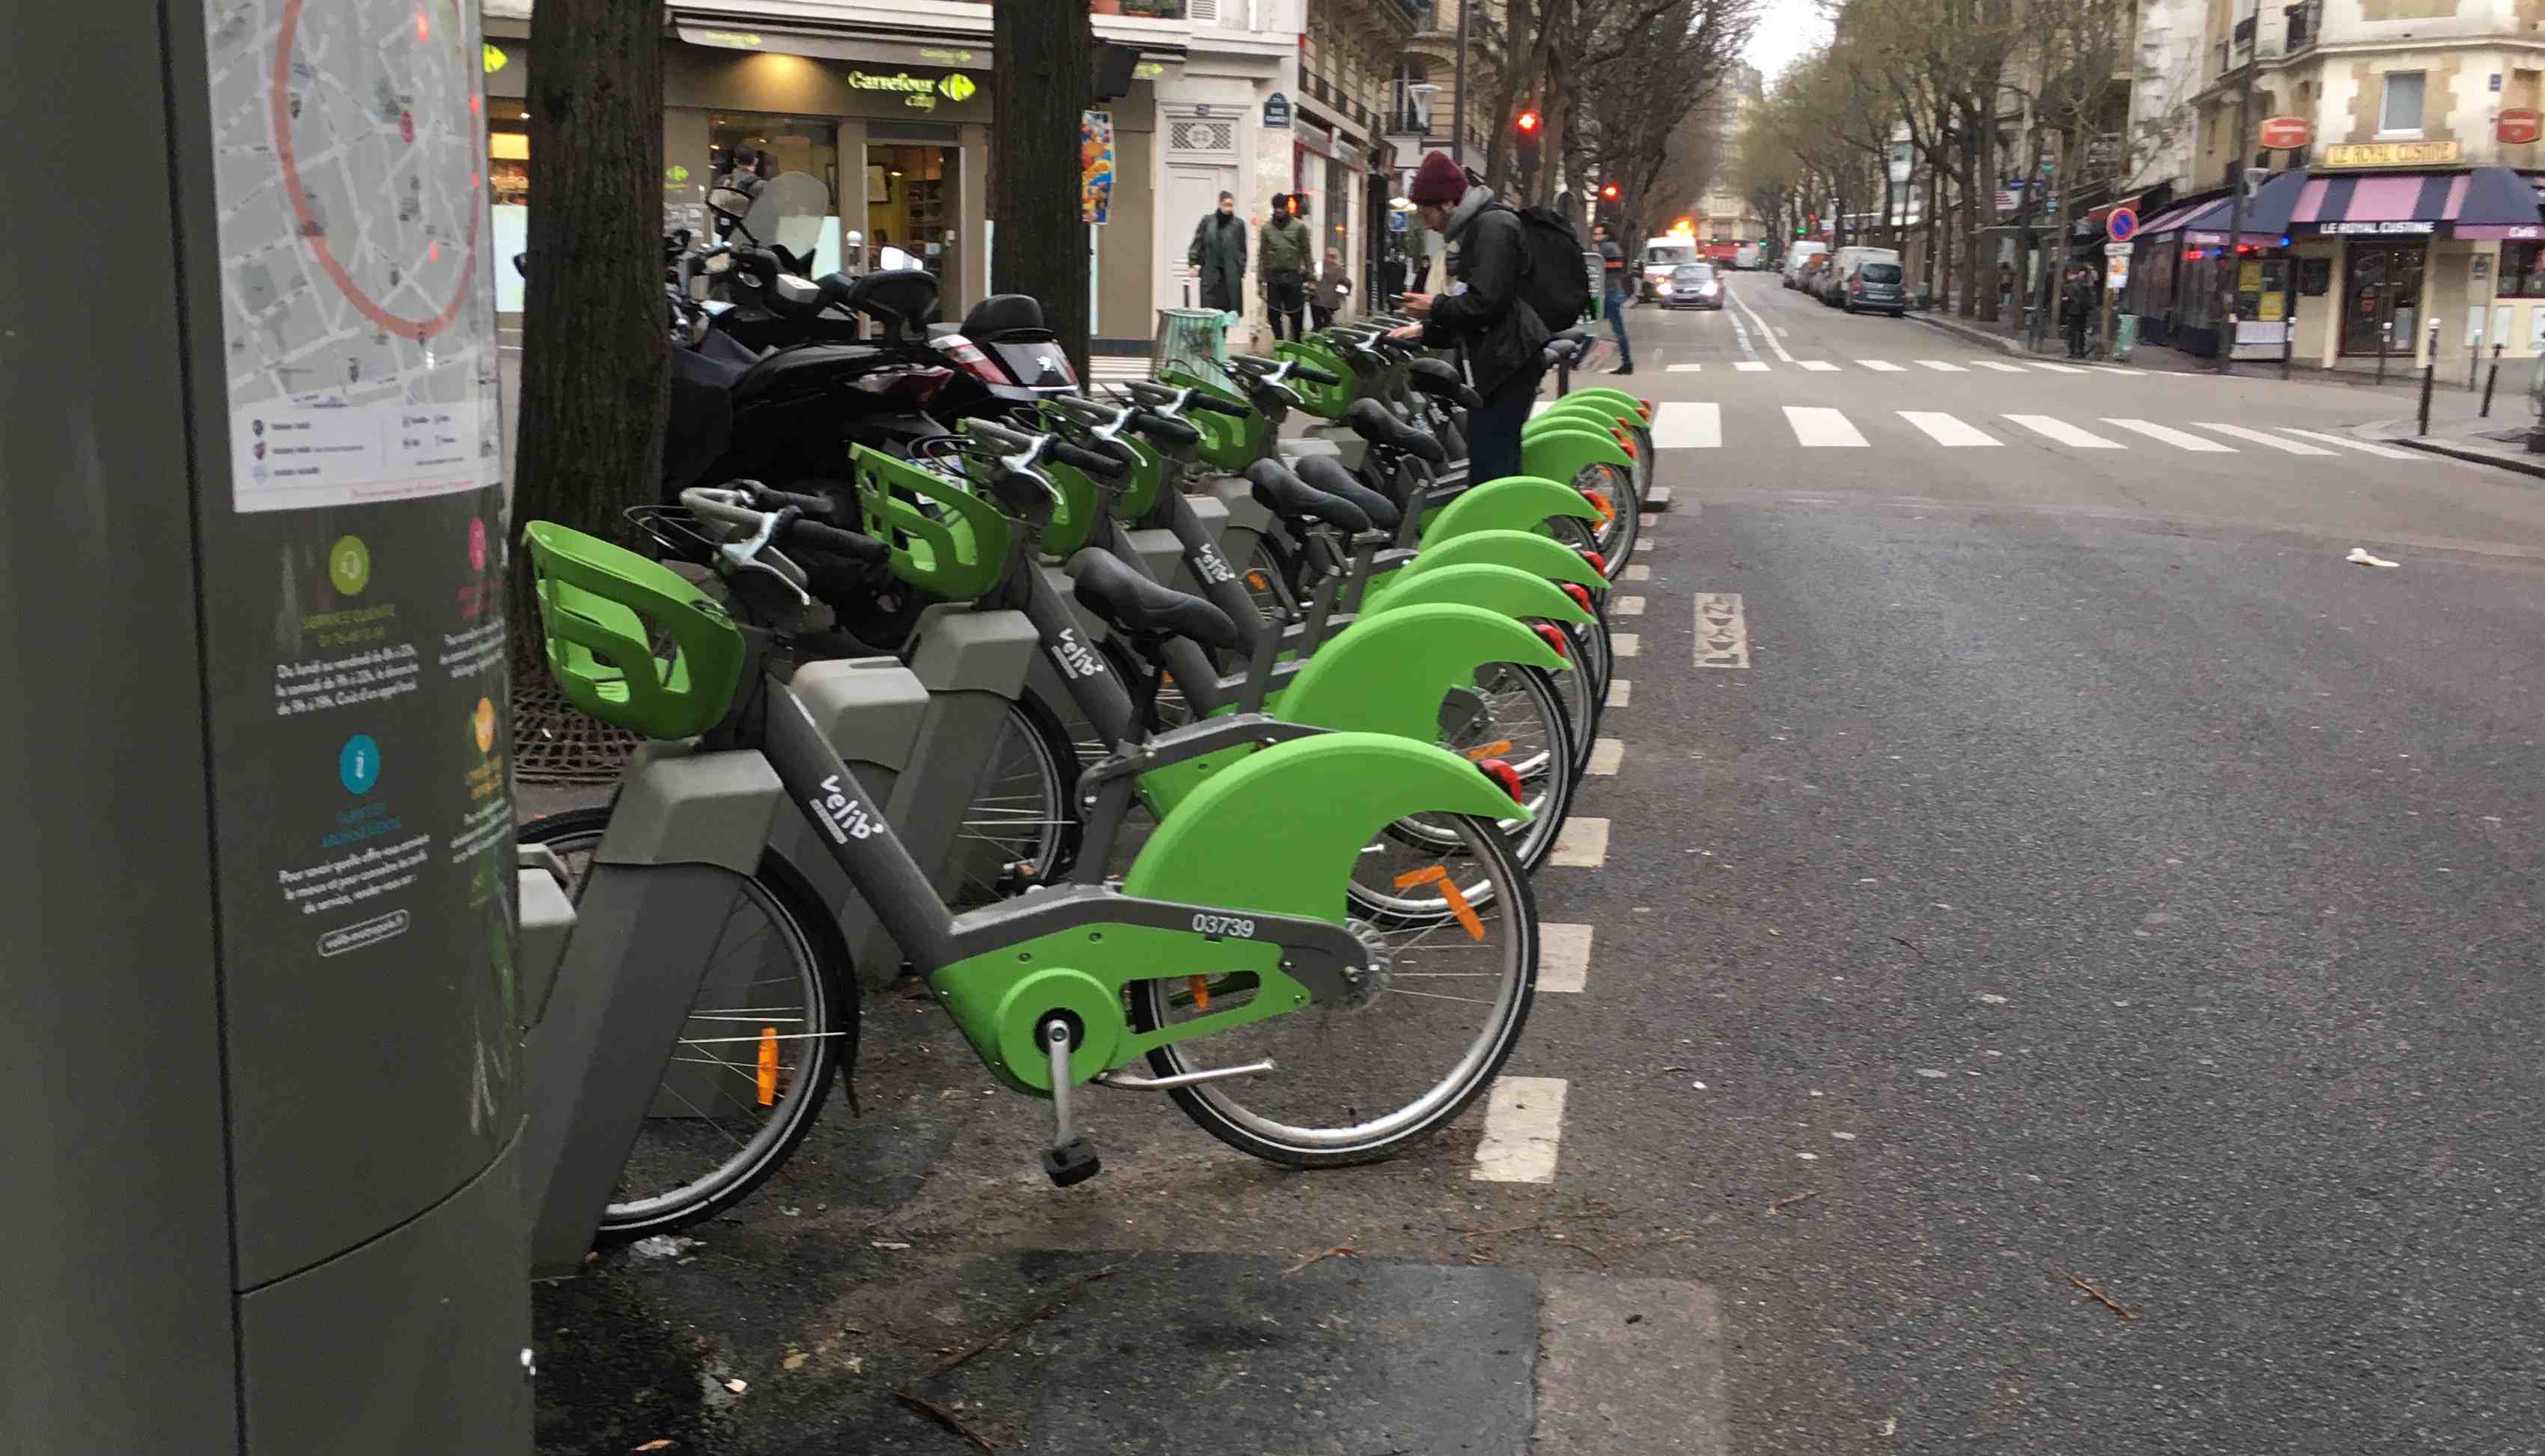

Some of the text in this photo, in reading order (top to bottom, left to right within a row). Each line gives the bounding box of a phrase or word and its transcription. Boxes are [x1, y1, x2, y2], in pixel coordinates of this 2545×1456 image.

[848, 71, 936, 93] Carrefour
[2320, 222, 2338, 234] LE
[1191, 913, 1256, 937] 03739
